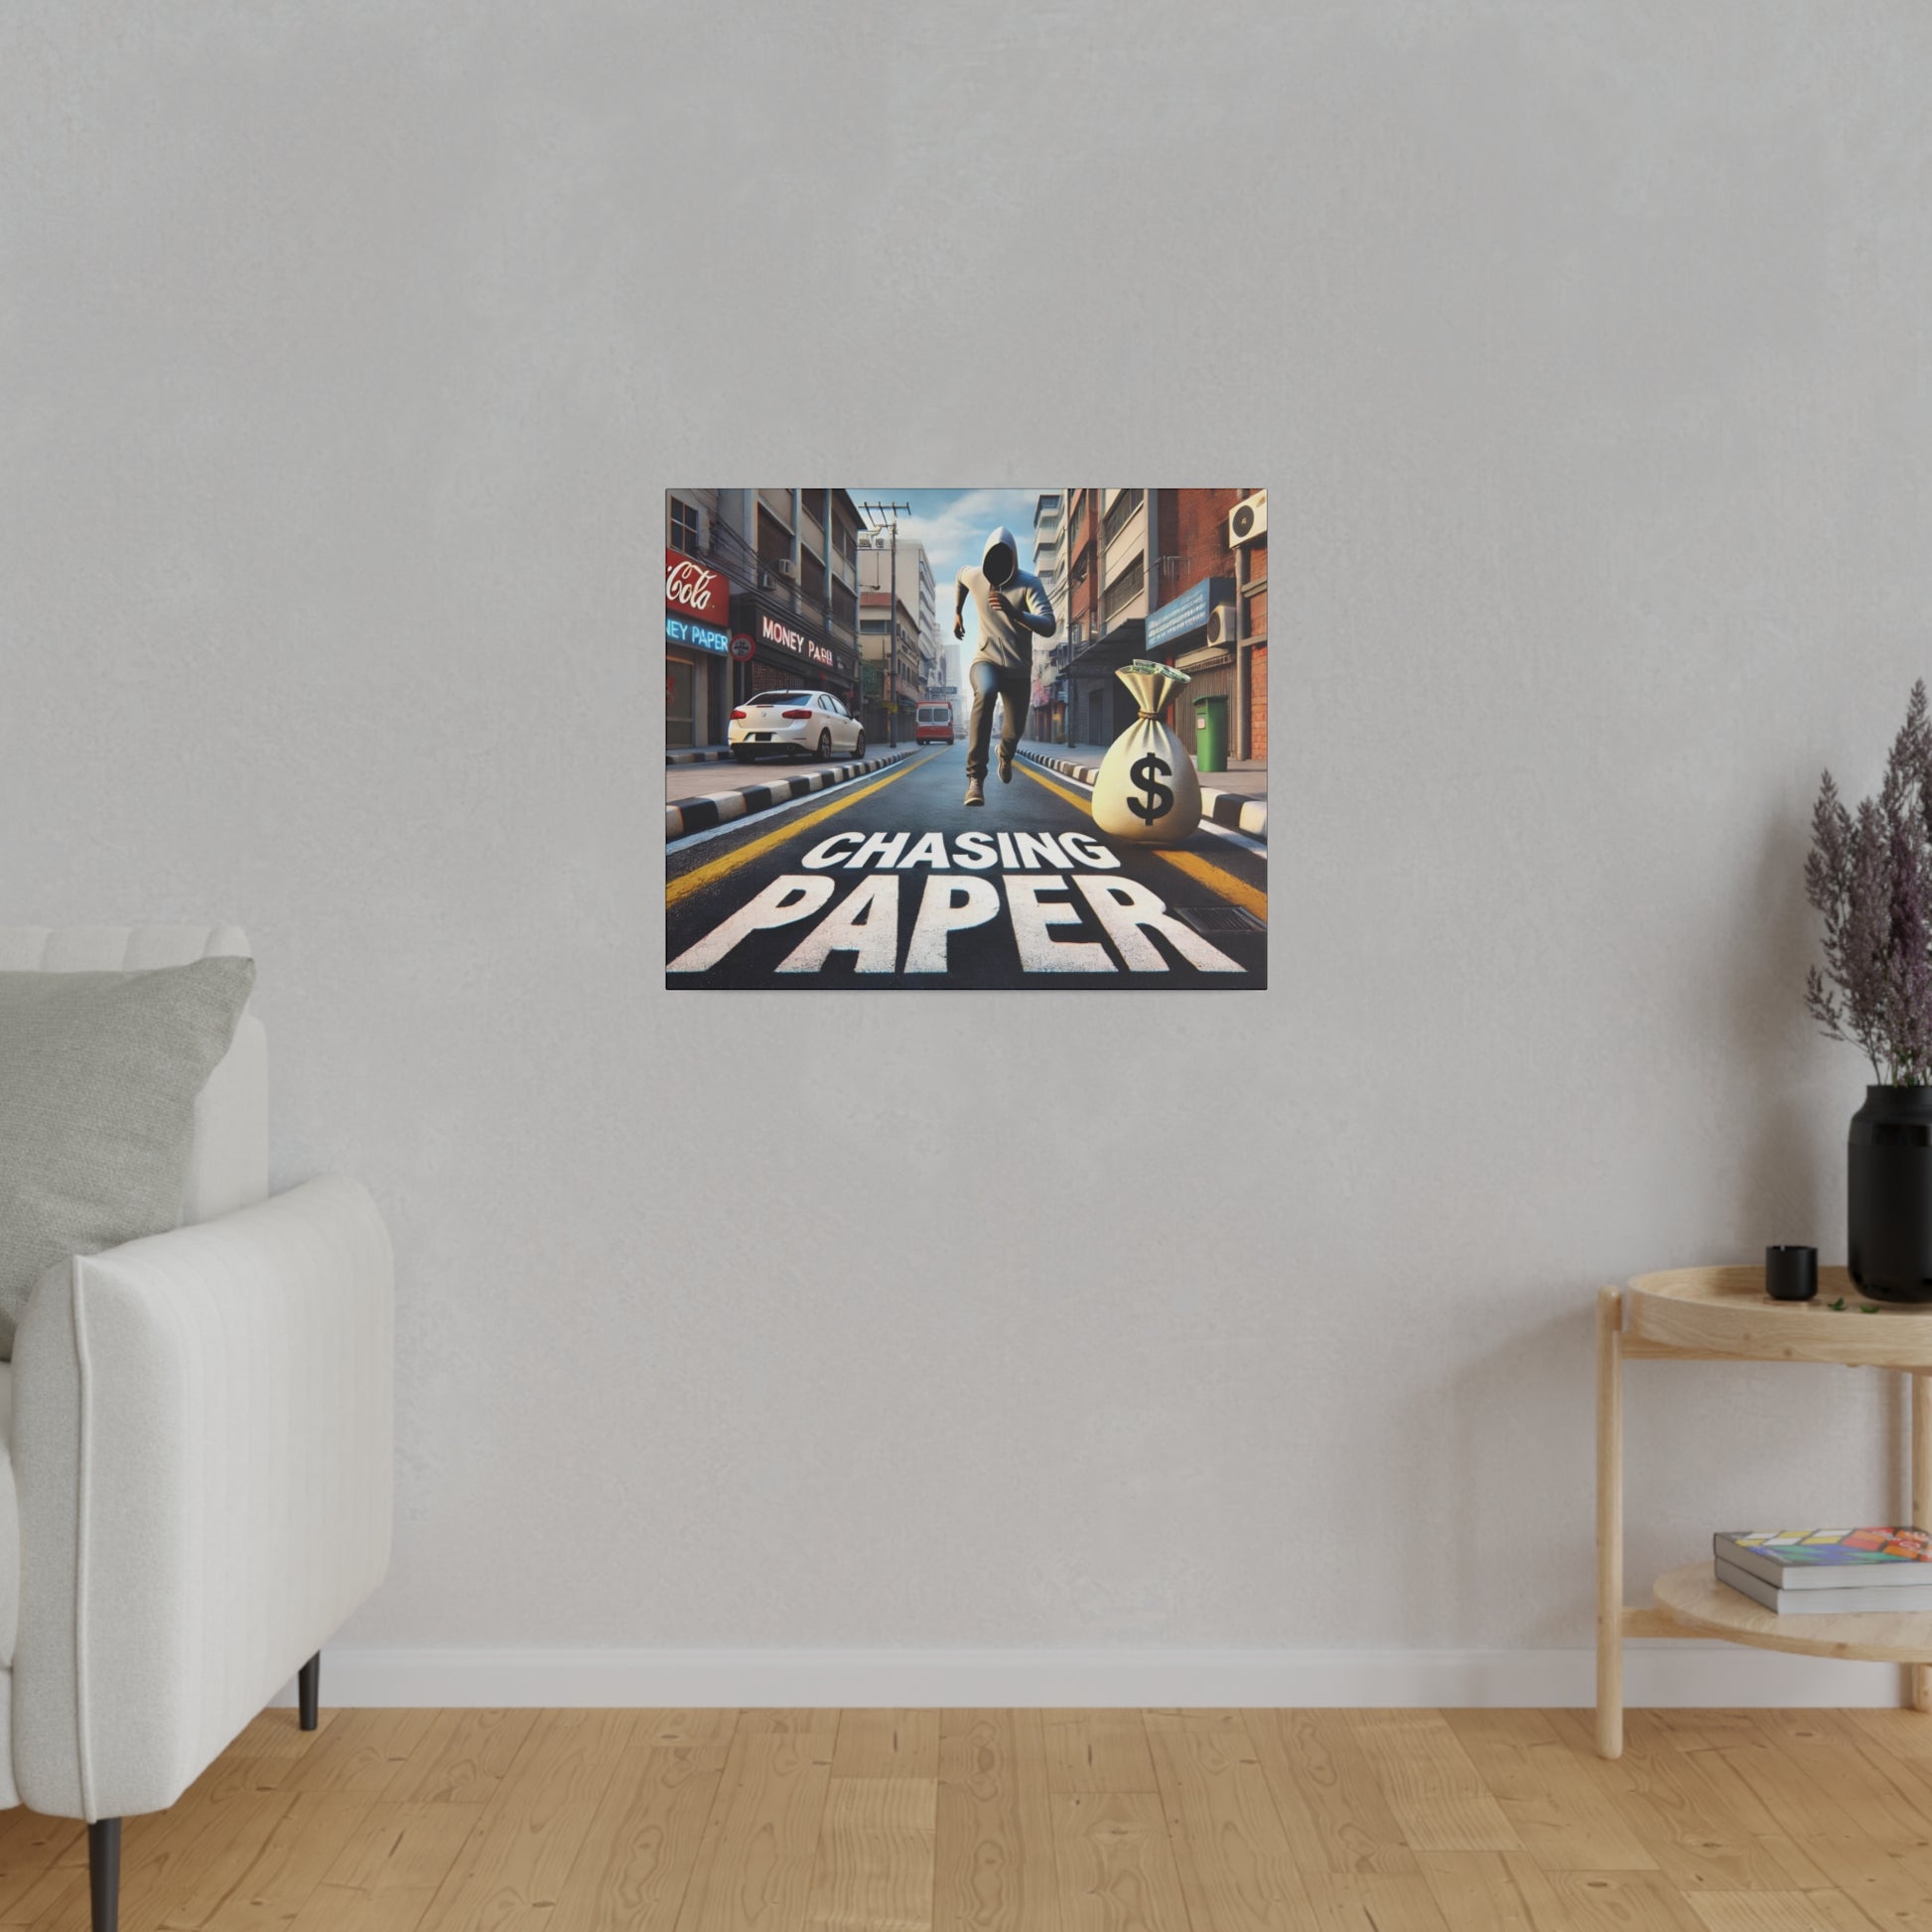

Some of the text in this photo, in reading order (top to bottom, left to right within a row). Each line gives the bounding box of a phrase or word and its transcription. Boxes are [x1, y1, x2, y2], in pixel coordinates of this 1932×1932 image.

[666, 561, 717, 610] Cola
[691, 625, 730, 652] PAPER
[762, 616, 804, 653] MONEY
[1126, 752, 1174, 826] $
[801, 831, 1121, 869] CHASING
[666, 874, 1248, 973] PAPER
